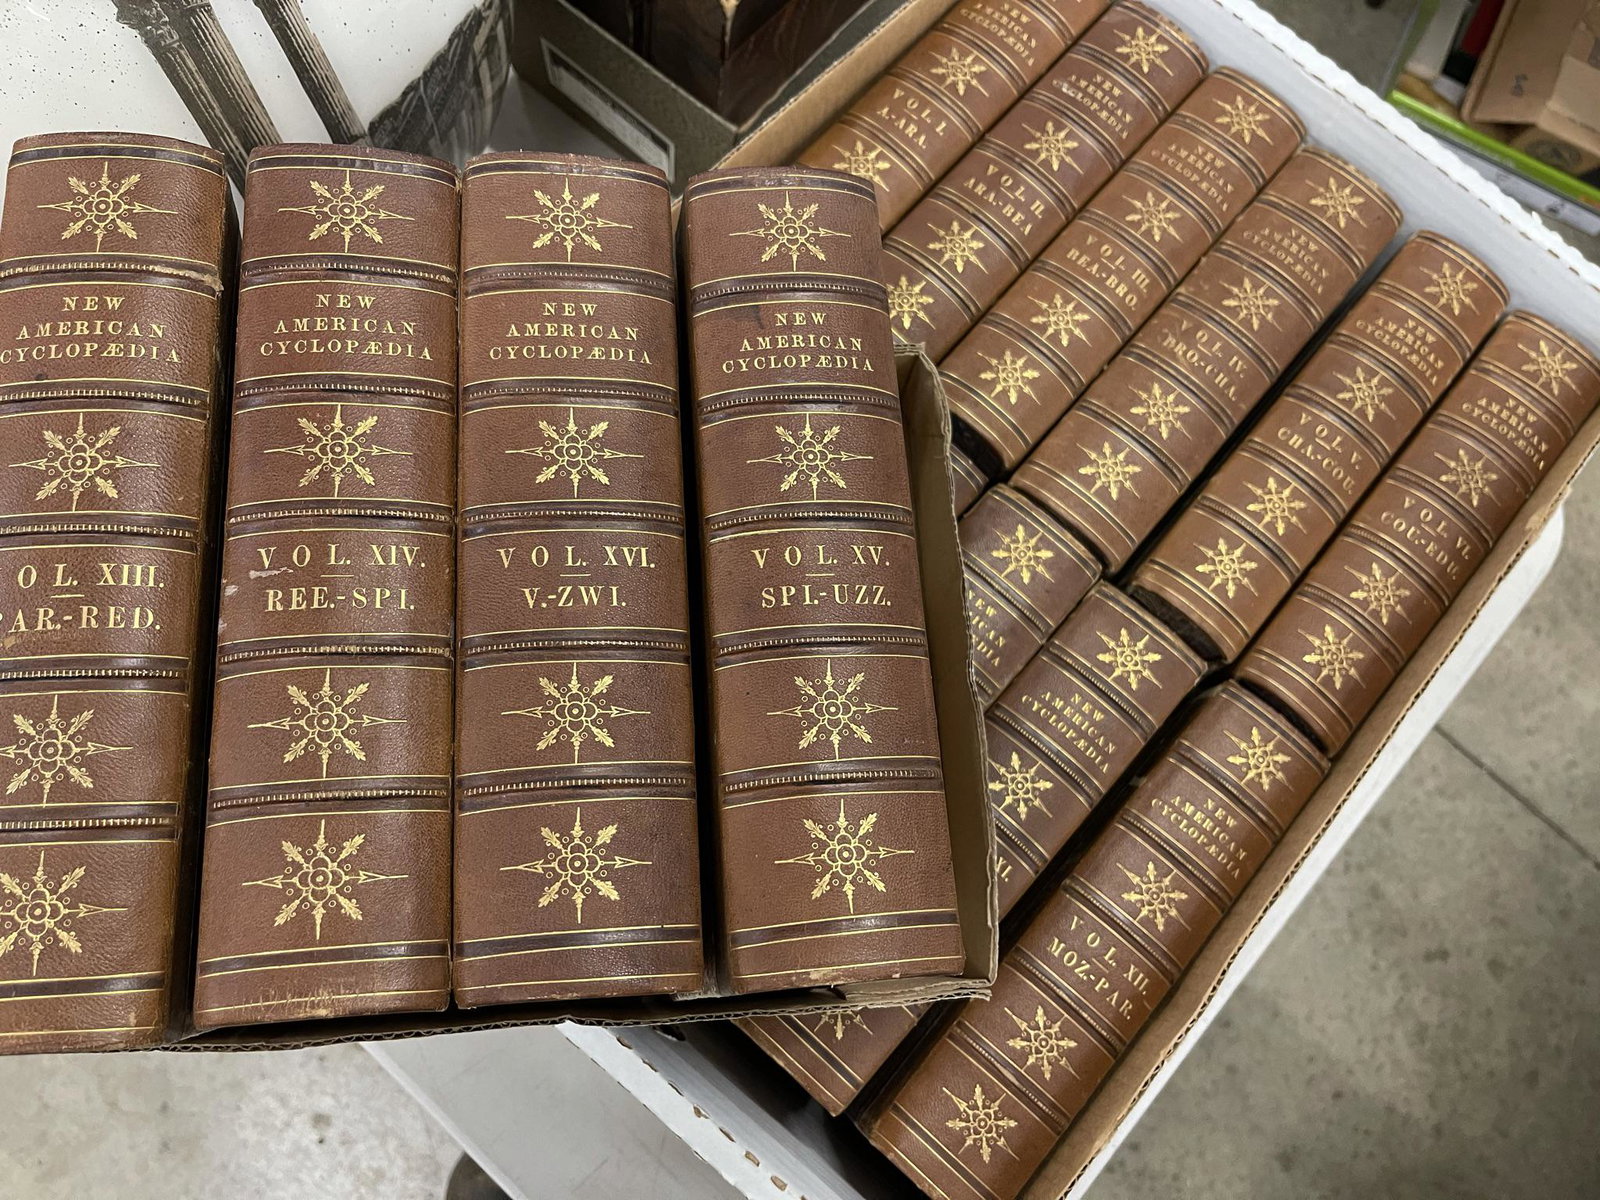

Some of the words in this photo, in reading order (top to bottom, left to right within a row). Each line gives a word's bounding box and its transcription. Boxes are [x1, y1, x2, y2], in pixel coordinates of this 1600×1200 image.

[62, 296, 125, 311] NEW
[315, 293, 377, 310] NEW
[543, 303, 598, 317] NEW
[16, 320, 166, 340] AMERICAN
[273, 318, 417, 336] AMERICAN
[774, 312, 827, 327] NEW
[1404, 318, 1437, 344] NEW
[506, 323, 639, 341] AMERICAN
[739, 335, 863, 352] AMERICAN
[1375, 317, 1444, 369] AMERICAN
[1505, 398, 1537, 423] NEW
[1477, 397, 1548, 453] AMERICAN
[369, 544, 426, 568] XIV.
[602, 546, 656, 569] XVI.
[851, 546, 891, 567] XV.
[0, 563, 79, 589] OL.
[96, 563, 165, 588] XIII.
[0, 605, 161, 632] AR.-RED.
[1070, 693, 1105, 722] NEW
[1041, 691, 1116, 755] AMERICAN
[1203, 798, 1238, 828] NEW
[1170, 796, 1248, 860] AMERICAN
[1122, 963, 1148, 996] XII.
